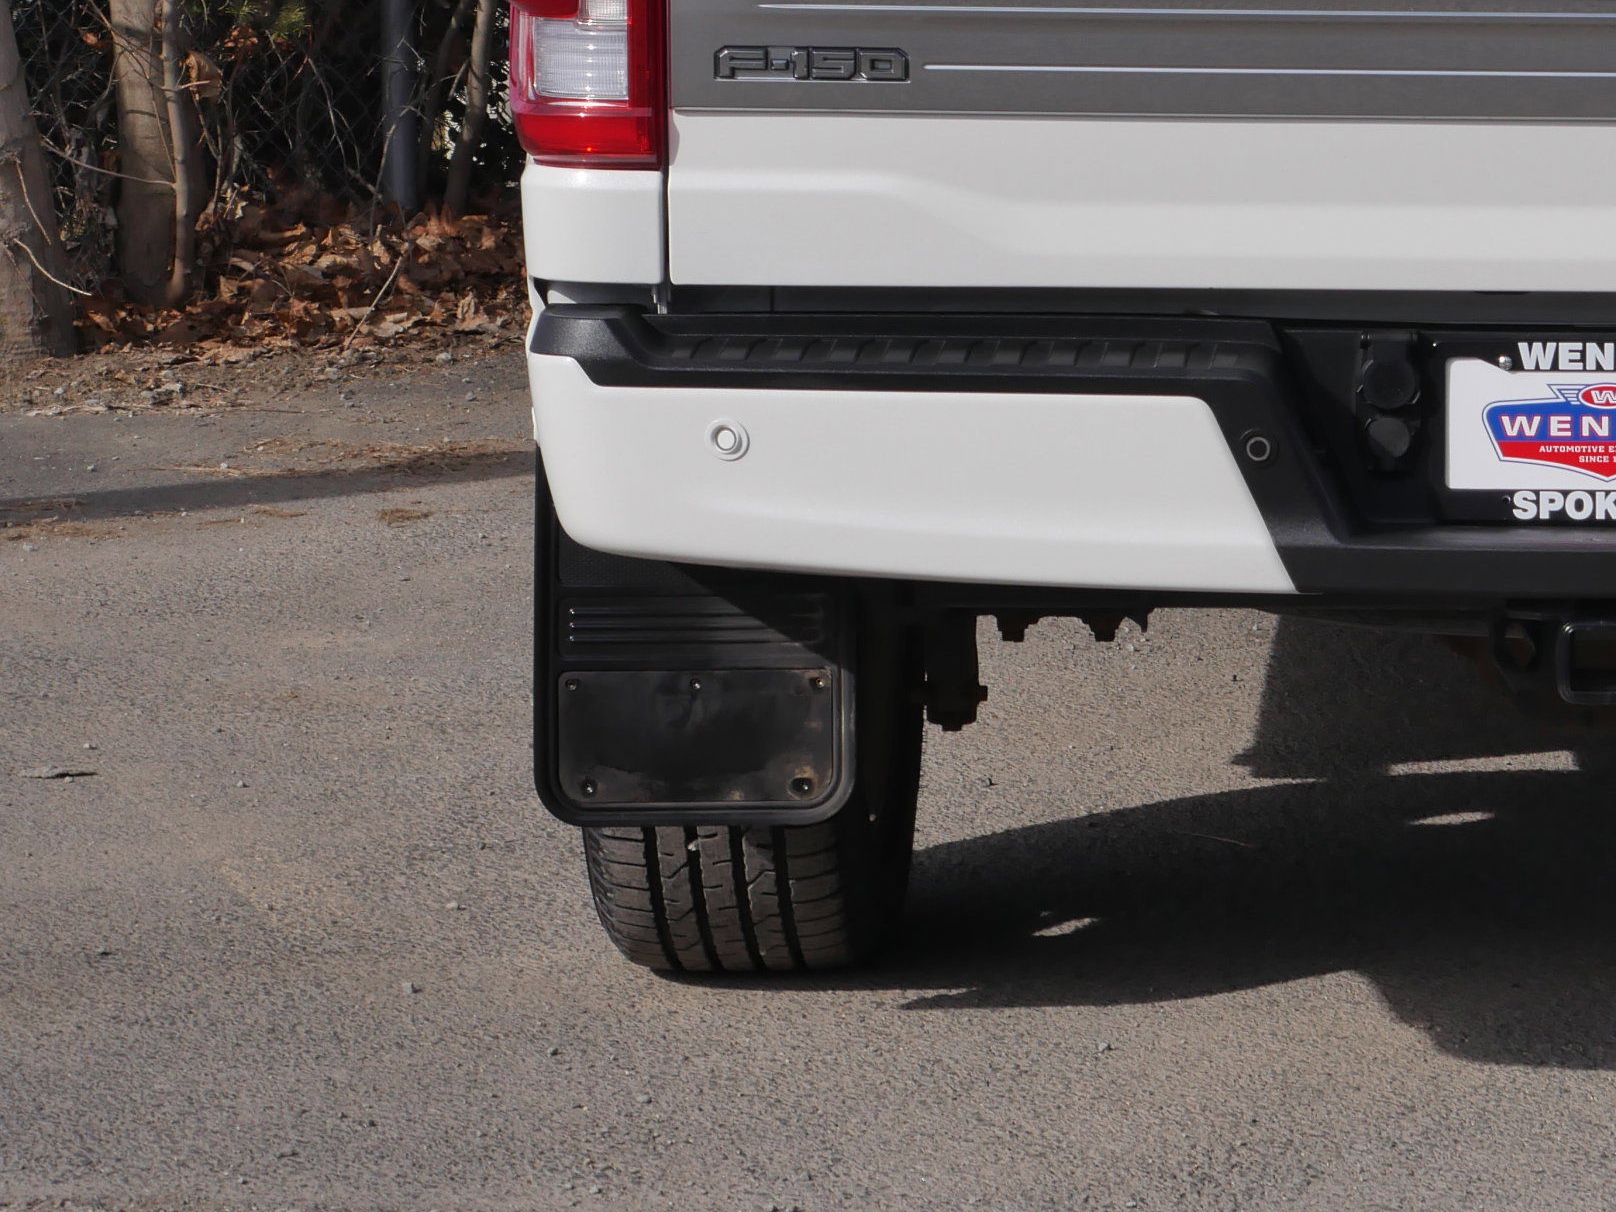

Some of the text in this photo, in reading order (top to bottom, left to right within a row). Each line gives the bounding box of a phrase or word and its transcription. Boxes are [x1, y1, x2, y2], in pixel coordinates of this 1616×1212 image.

[713, 45, 911, 83] F-150
[1538, 445, 1605, 454] AUTOMOTIVE
[1578, 455, 1610, 464] SINCE
